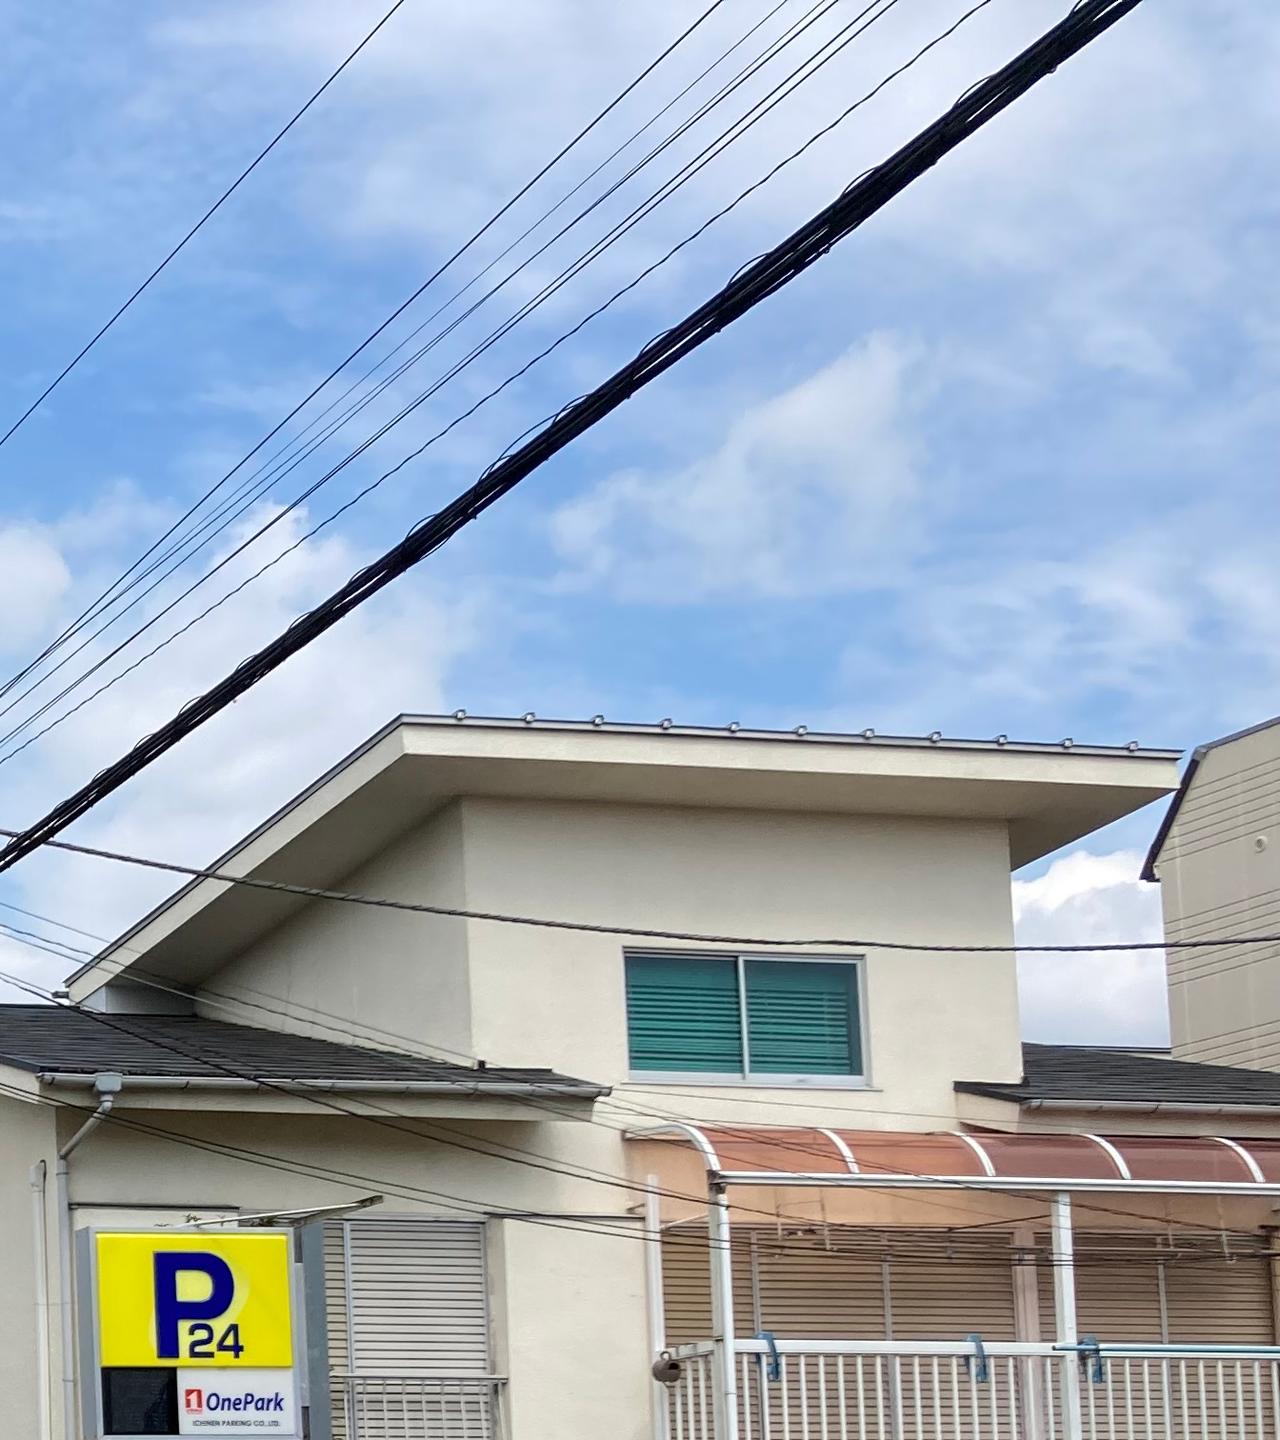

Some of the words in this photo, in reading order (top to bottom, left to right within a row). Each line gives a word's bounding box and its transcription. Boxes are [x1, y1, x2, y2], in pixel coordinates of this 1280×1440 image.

[153, 1251, 235, 1358] P
[188, 1323, 244, 1359] 24
[206, 1392, 284, 1412] OnePark
